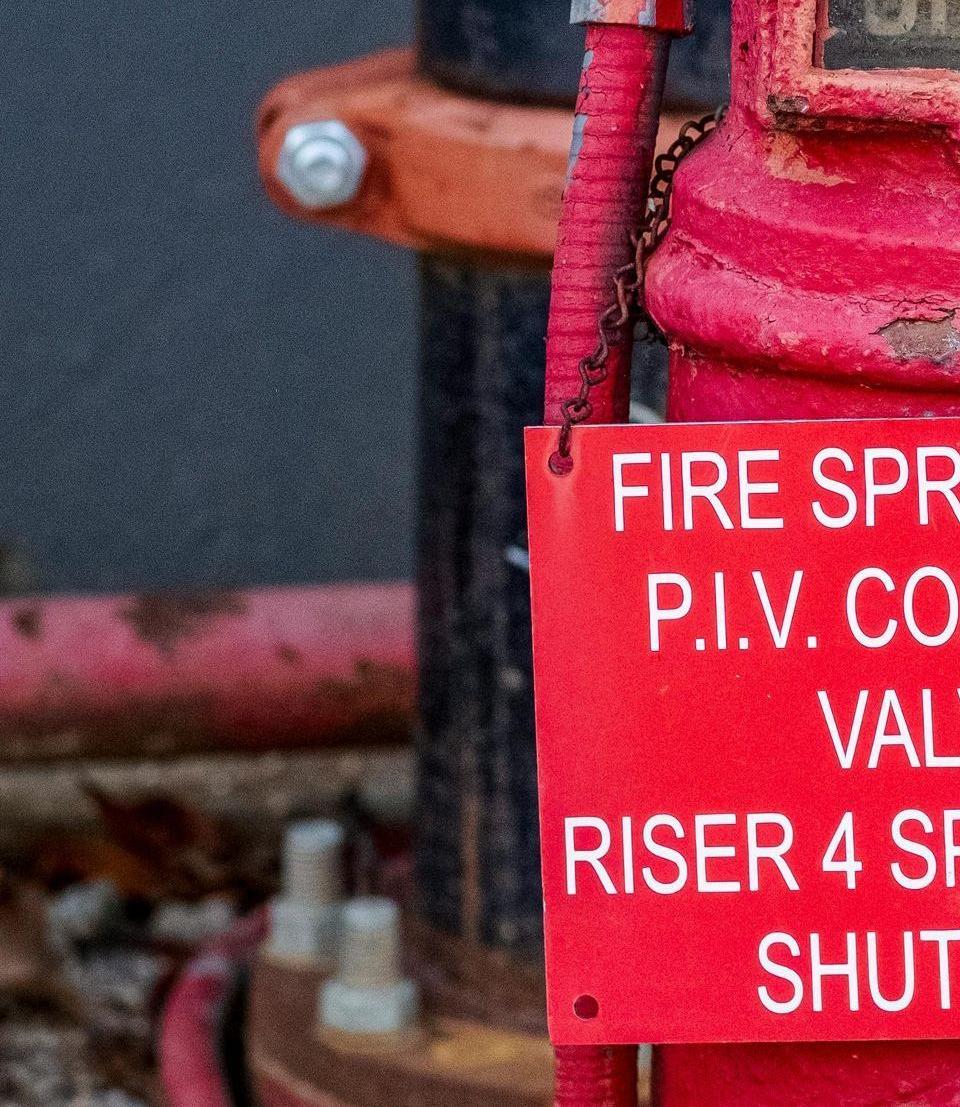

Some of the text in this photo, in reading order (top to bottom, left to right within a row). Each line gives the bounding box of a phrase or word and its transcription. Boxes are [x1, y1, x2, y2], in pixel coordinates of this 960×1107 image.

[612, 449, 784, 532] FIRE
[647, 570, 819, 652] P.I.V.
[564, 812, 800, 895] RISER
[821, 811, 863, 891] 4
